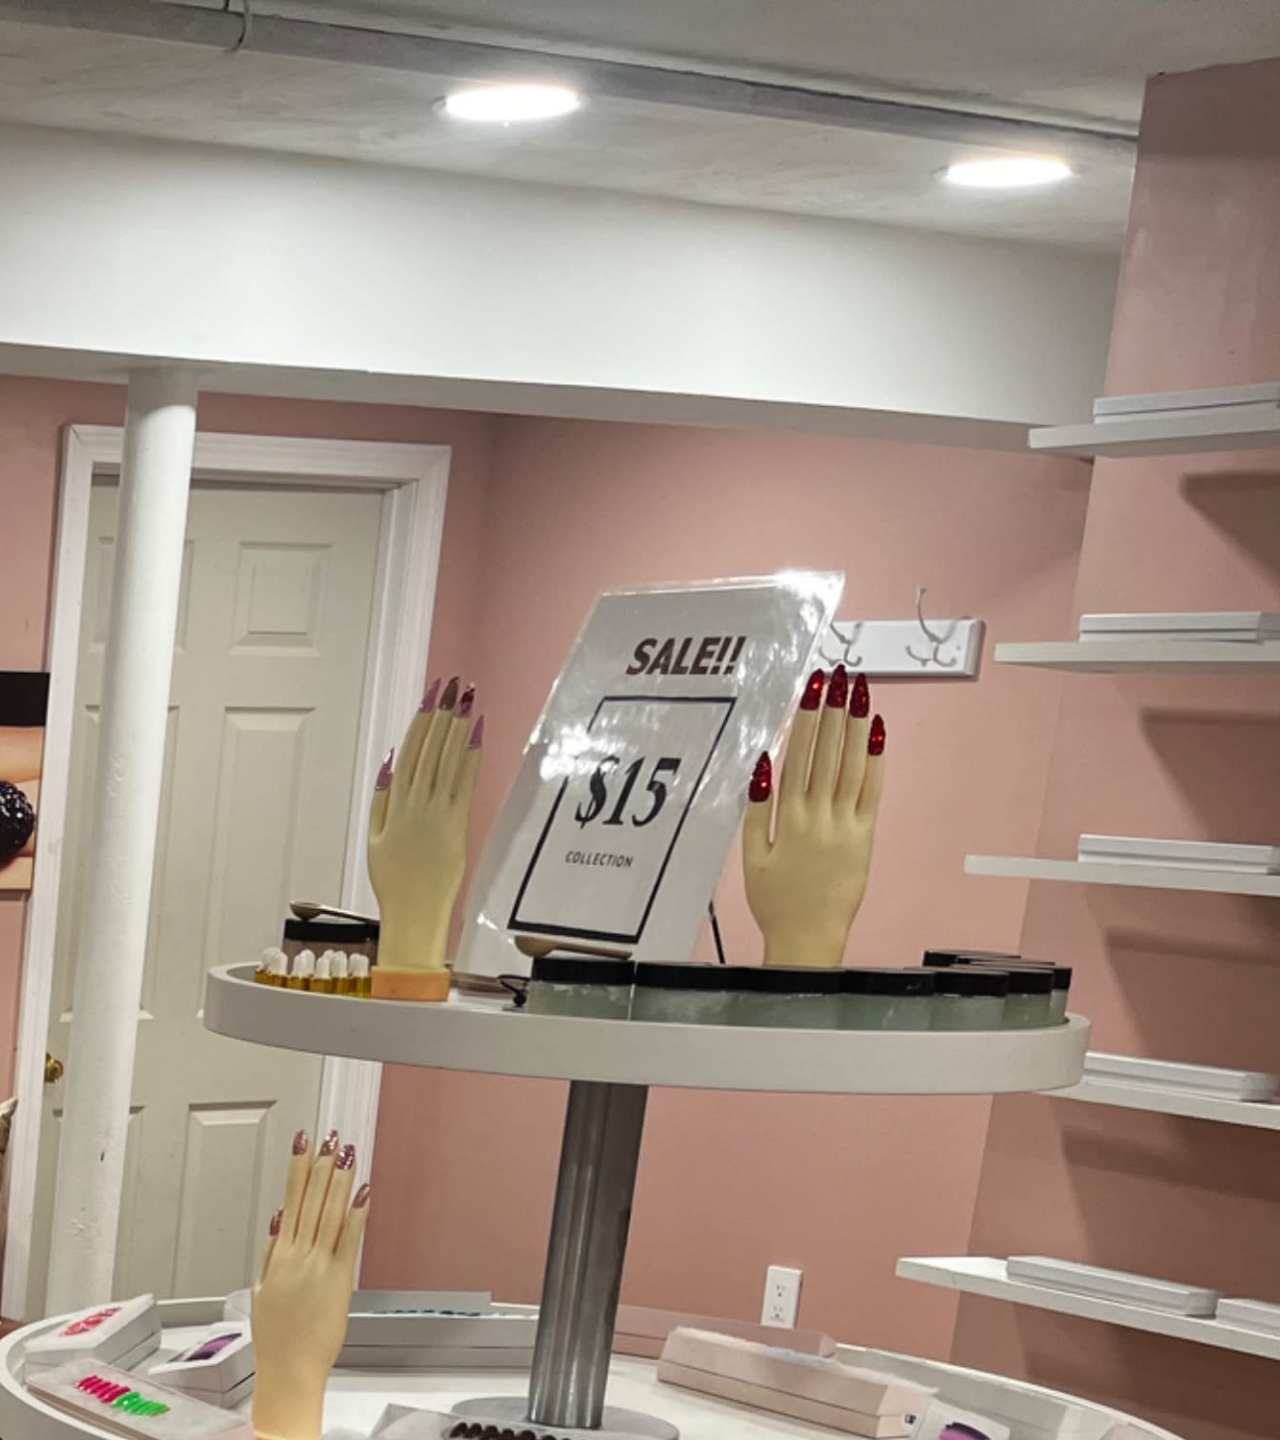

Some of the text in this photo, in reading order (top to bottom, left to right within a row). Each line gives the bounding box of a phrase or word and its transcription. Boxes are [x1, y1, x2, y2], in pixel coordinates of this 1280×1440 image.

[626, 636, 746, 675] SALE!!
[574, 756, 681, 829] $15
[565, 850, 633, 868] COLLECTION
